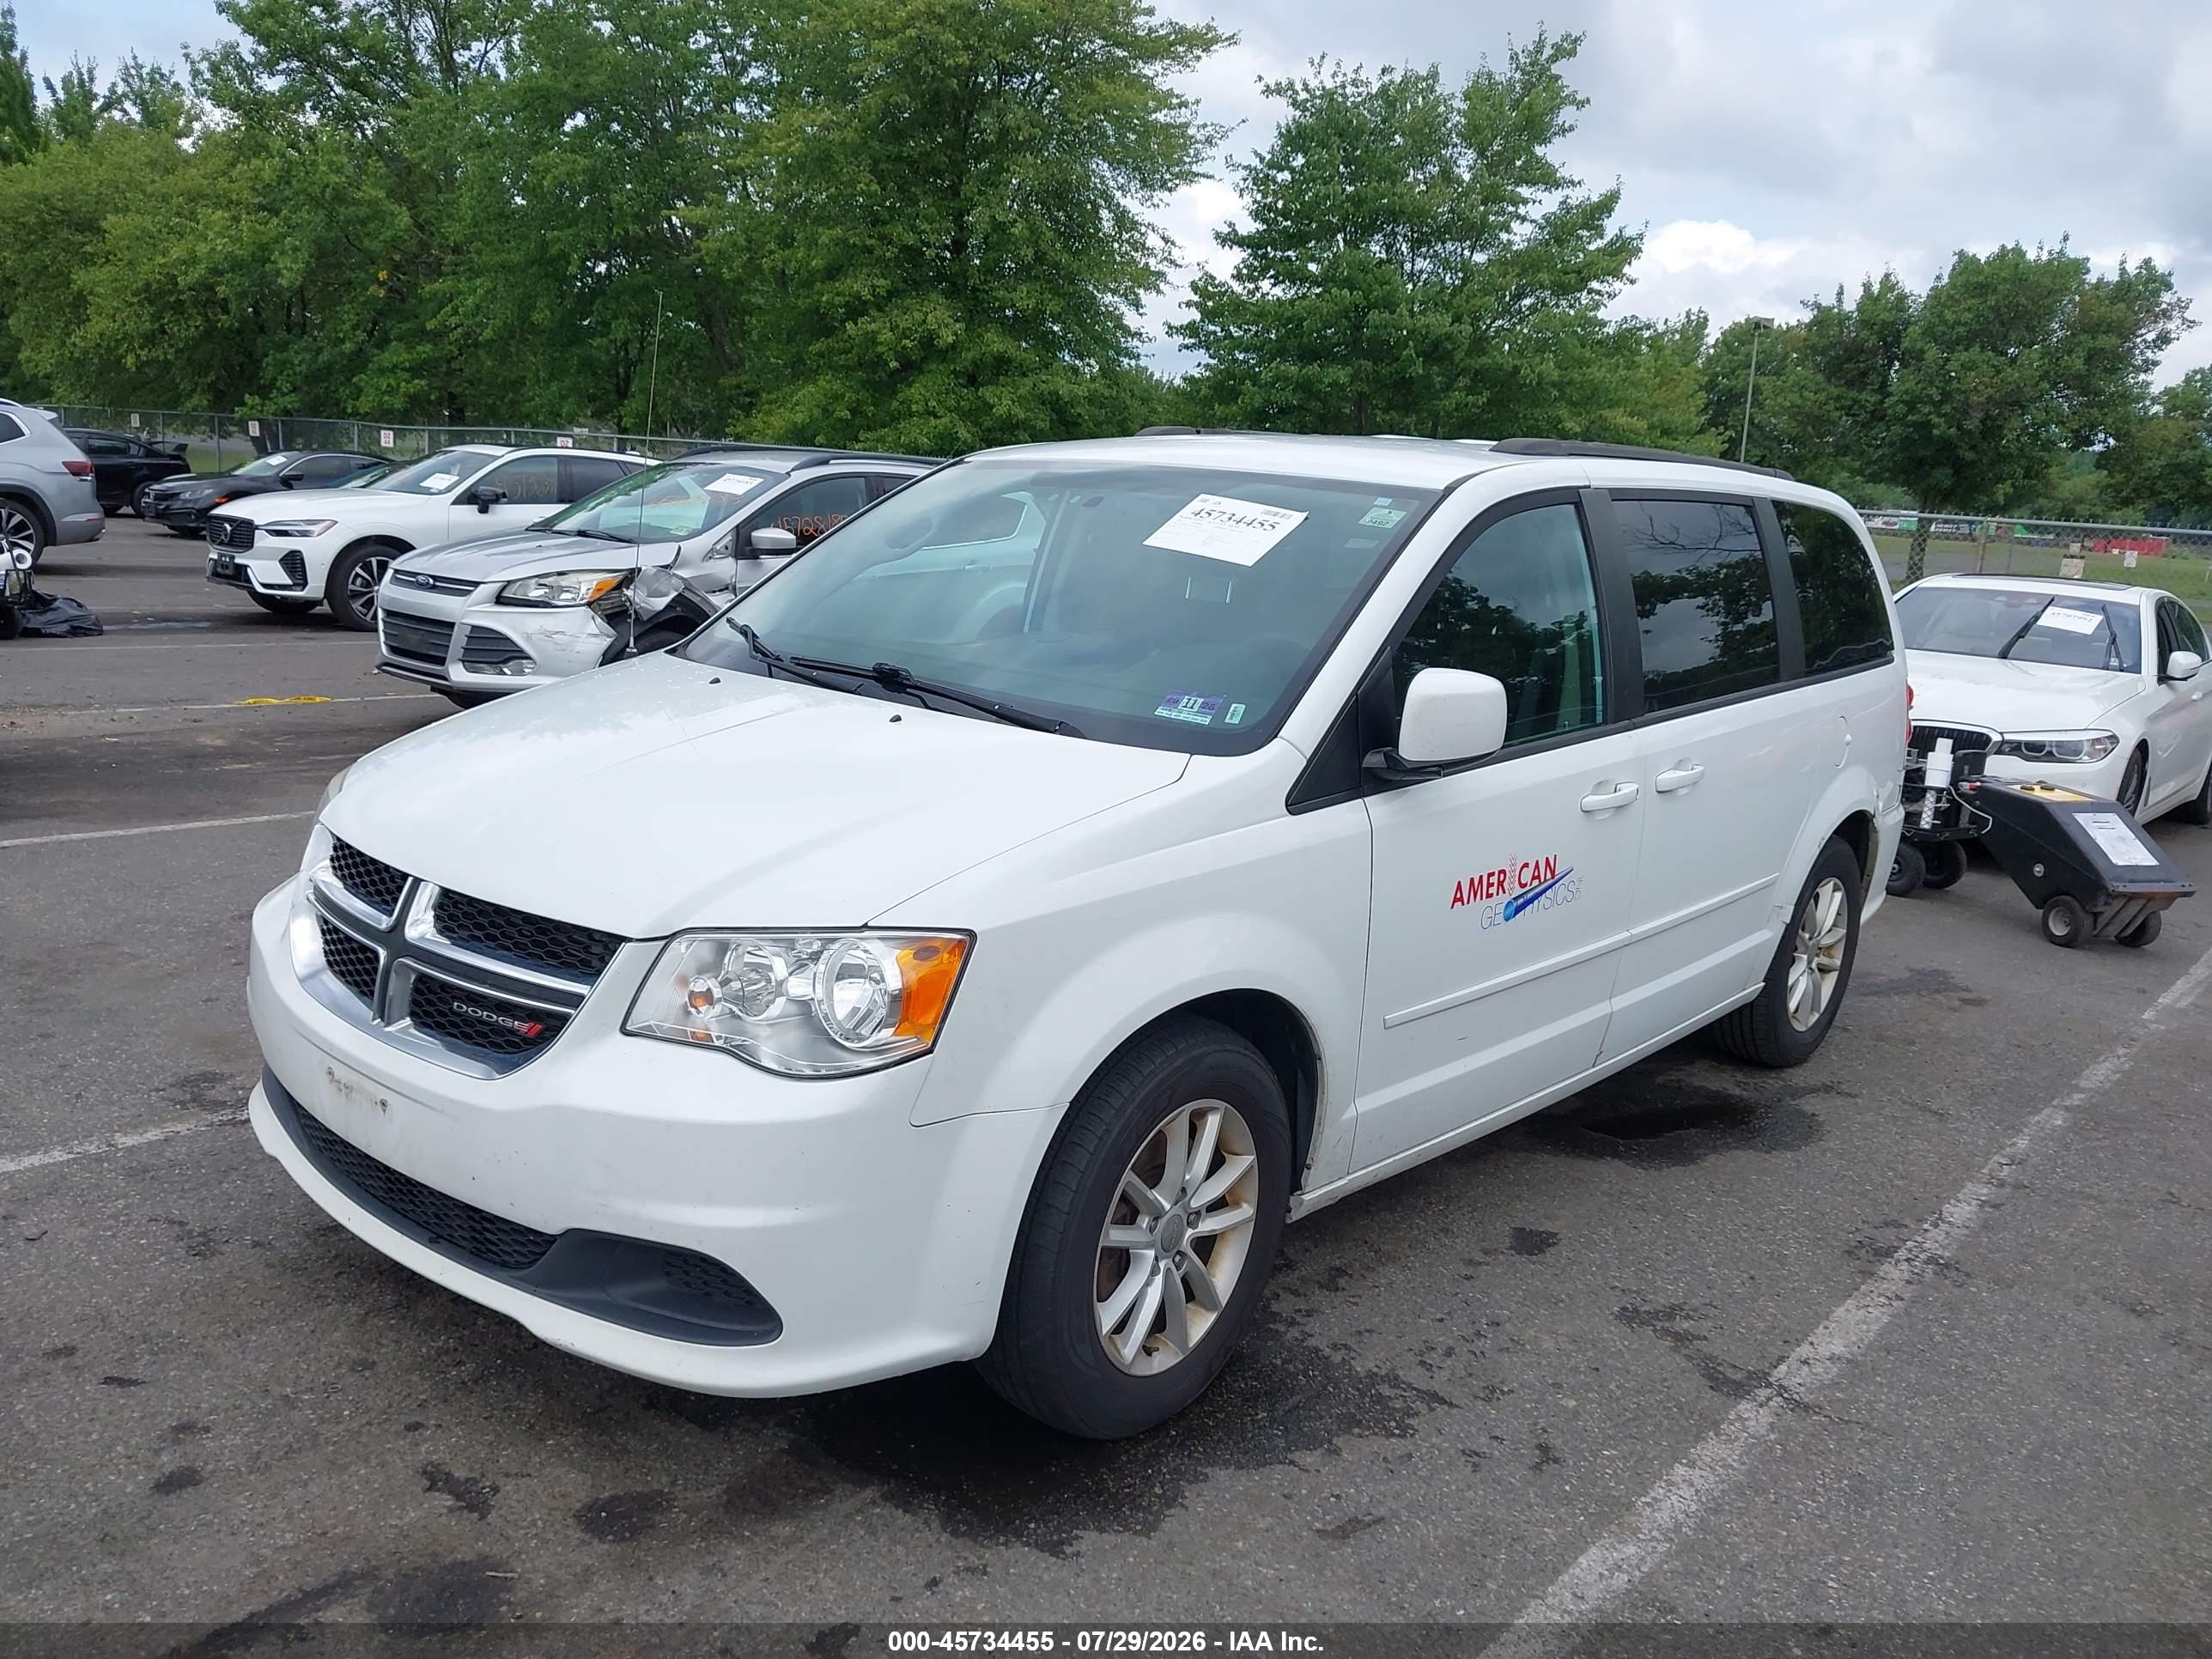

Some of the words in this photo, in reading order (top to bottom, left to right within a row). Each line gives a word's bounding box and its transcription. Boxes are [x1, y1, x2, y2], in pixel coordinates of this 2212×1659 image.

[1190, 507, 1281, 532] 45734455
[1182, 696, 1199, 709] 11
[1200, 700, 1217, 711] 26
[1480, 879, 1577, 930] GEOYSICS
[453, 1001, 530, 1033] DODGE
